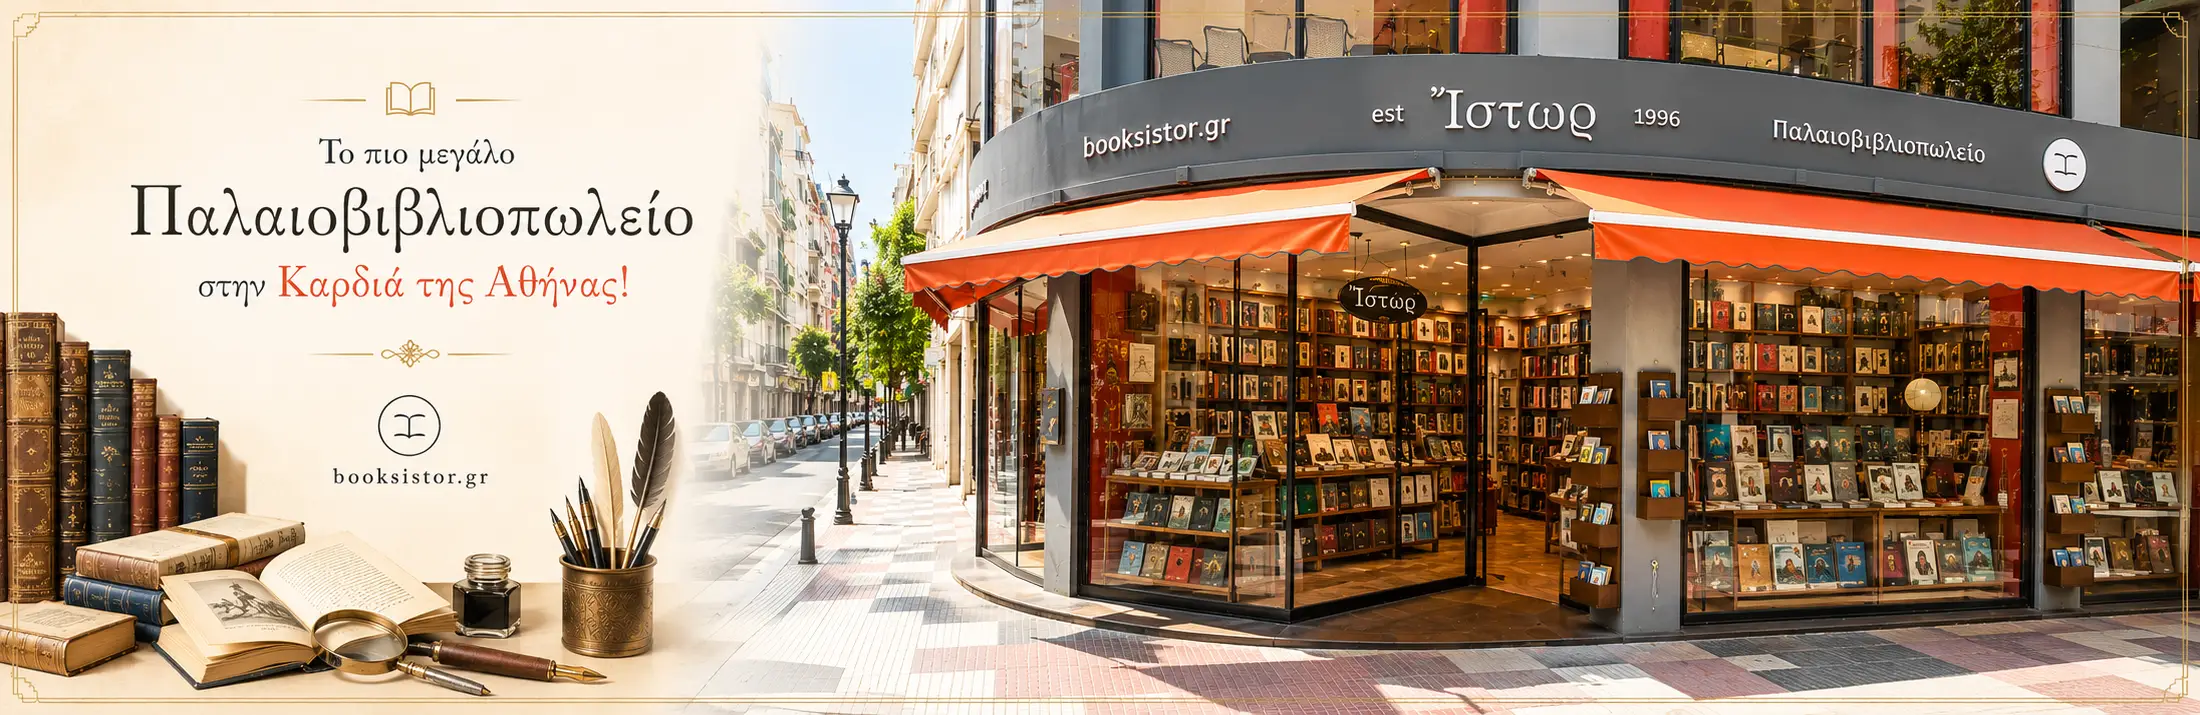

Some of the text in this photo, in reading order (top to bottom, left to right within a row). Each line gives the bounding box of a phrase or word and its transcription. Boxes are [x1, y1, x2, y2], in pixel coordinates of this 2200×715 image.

[1371, 104, 1405, 123] est
[1634, 108, 1681, 127] 1996
[1083, 117, 1231, 159] booksistor.gr
[1773, 119, 1986, 164] Παλαιοβιβλιοπωλείο
